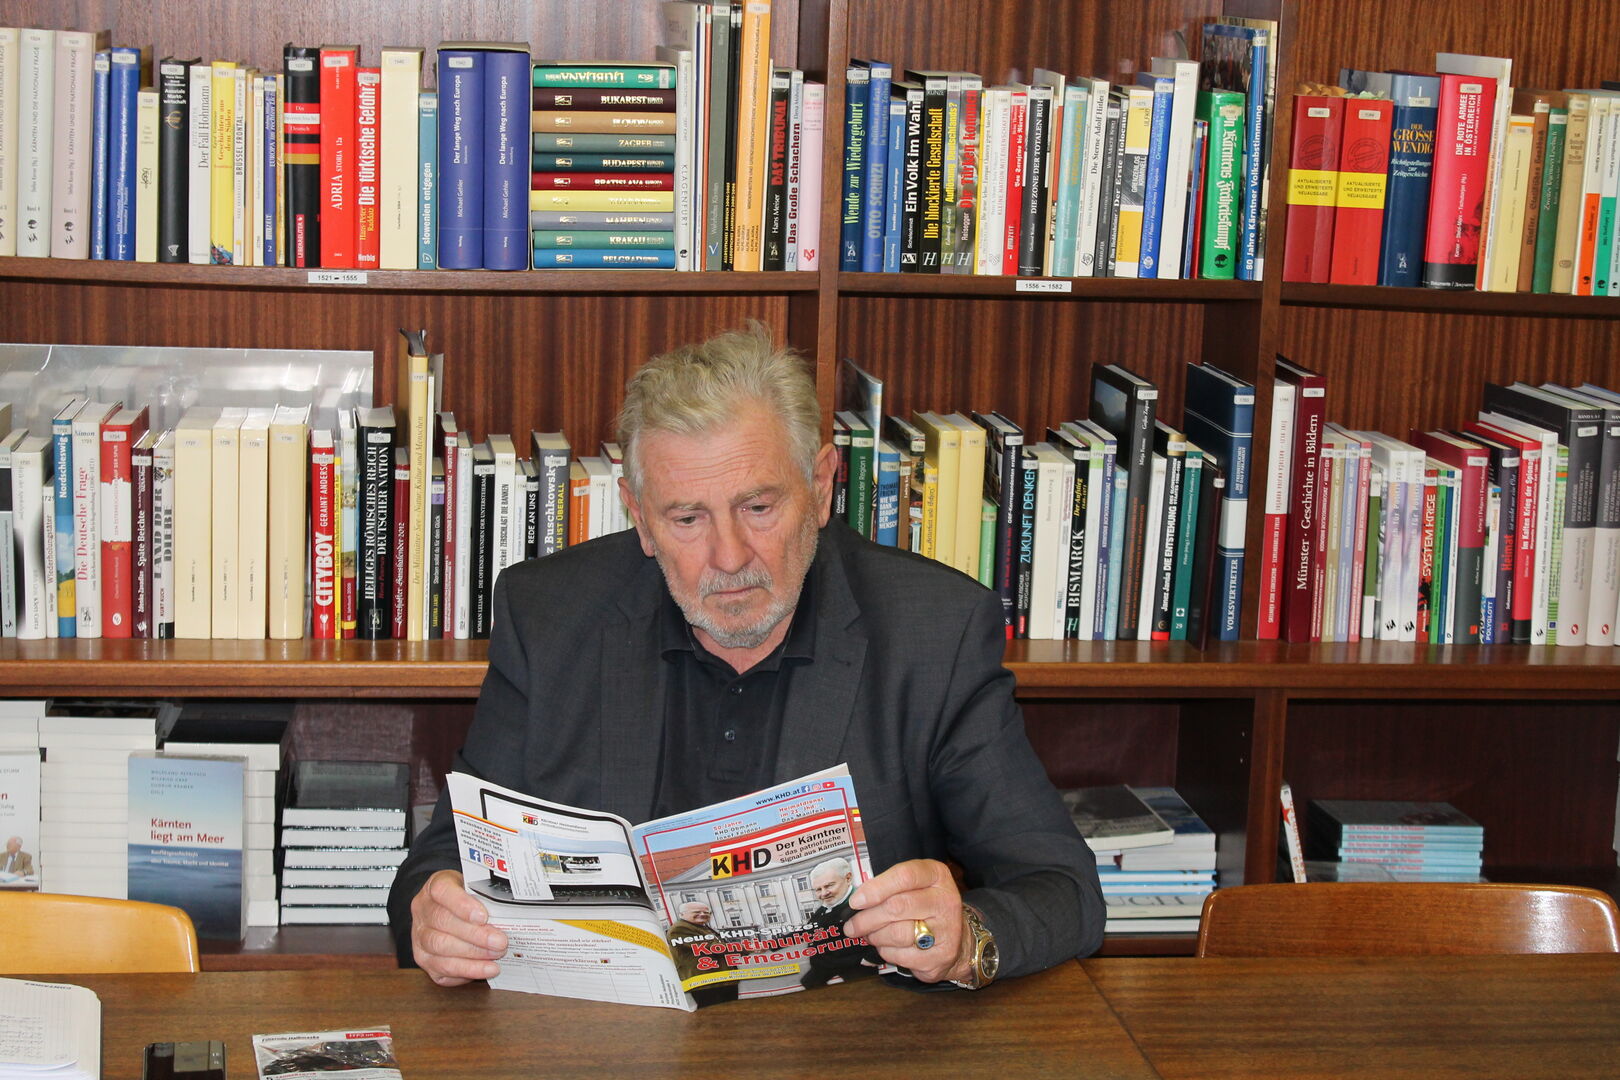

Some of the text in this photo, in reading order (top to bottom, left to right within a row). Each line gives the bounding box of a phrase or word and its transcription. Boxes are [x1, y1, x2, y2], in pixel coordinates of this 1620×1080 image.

[1459, 94, 1467, 120] ARMEE
[1465, 95, 1476, 144] ÖSTERREICH
[199, 86, 209, 168] Der Fall Hohmann
[358, 82, 375, 205] Die türkische Gefahr?
[500, 134, 508, 151] lange
[772, 100, 786, 159] TRIBUNAL
[1034, 120, 1043, 156] TOTALEN
[1394, 129, 1434, 142] GROSSE
[1457, 122, 1465, 141] ROTE
[790, 123, 800, 183] Schachern
[844, 103, 864, 224] Wende zur Wiedergeburt
[908, 140, 919, 156] im
[945, 103, 957, 202] Auflösung Deutschlands?
[958, 90, 977, 208] Die Türken kommen
[1250, 105, 1262, 186] Volksabstimmung
[1393, 141, 1432, 153] WENDIG
[423, 163, 432, 200] entgegen
[772, 162, 784, 185] DAS
[907, 159, 919, 190] Volk
[924, 108, 943, 238] Die blockierte Gesellschaft
[1131, 156, 1141, 192] GRENZENLOS
[1214, 128, 1237, 250] Kärntens Freiheitskampf
[331, 175, 343, 210] ADRIA
[788, 188, 798, 220] Große
[868, 164, 884, 238] OTTO SCRINZI
[906, 192, 917, 212] Ein
[1248, 188, 1258, 229] Kärntner
[1246, 260, 1253, 270] 80
[58, 437, 68, 498] Nordschleswig
[377, 447, 388, 555] DEUTSCHER NATION
[555, 484, 564, 520] ÜBERALL
[1074, 478, 1083, 503] Aufstieg
[1297, 414, 1318, 590] Münster Geschichte in Bildern
[1521, 541, 1528, 549] Im
[1526, 459, 1534, 484] Spionag
[76, 467, 87, 580] Die Deutsche Frage
[320, 497, 328, 527] GERAINT
[365, 446, 376, 599] HEILIGES RÖMISCHES REICH
[528, 512, 535, 523] AN
[137, 510, 146, 567] Späte Beichte
[1022, 515, 1033, 563] ZUKUNFT
[1163, 506, 1176, 570] DIE ENTSTEHUNG
[1422, 495, 1436, 576] SYSTEM KRISE
[1502, 534, 1513, 570] Heimat
[316, 532, 333, 606] CITYBOY
[1068, 529, 1084, 607] BISMARCK
[1227, 560, 1238, 631] VOLKSVERTRETER
[1485, 601, 1494, 641] POLYGLOTT
[756, 789, 800, 805] www.KHD.at
[151, 819, 191, 829] Kärnten
[151, 831, 173, 842] liegt
[197, 834, 224, 843] Meer
[776, 826, 847, 851] Der Kärntner
[780, 854, 802, 863] Signal
[819, 841, 846, 853] Kärnten
[802, 835, 841, 850] patriotische
[713, 848, 772, 876] KHD
[670, 934, 714, 946] Neue
[720, 922, 818, 940] KHD-Spitze:
[691, 925, 840, 956] Kontinuität
[697, 957, 718, 970] &
